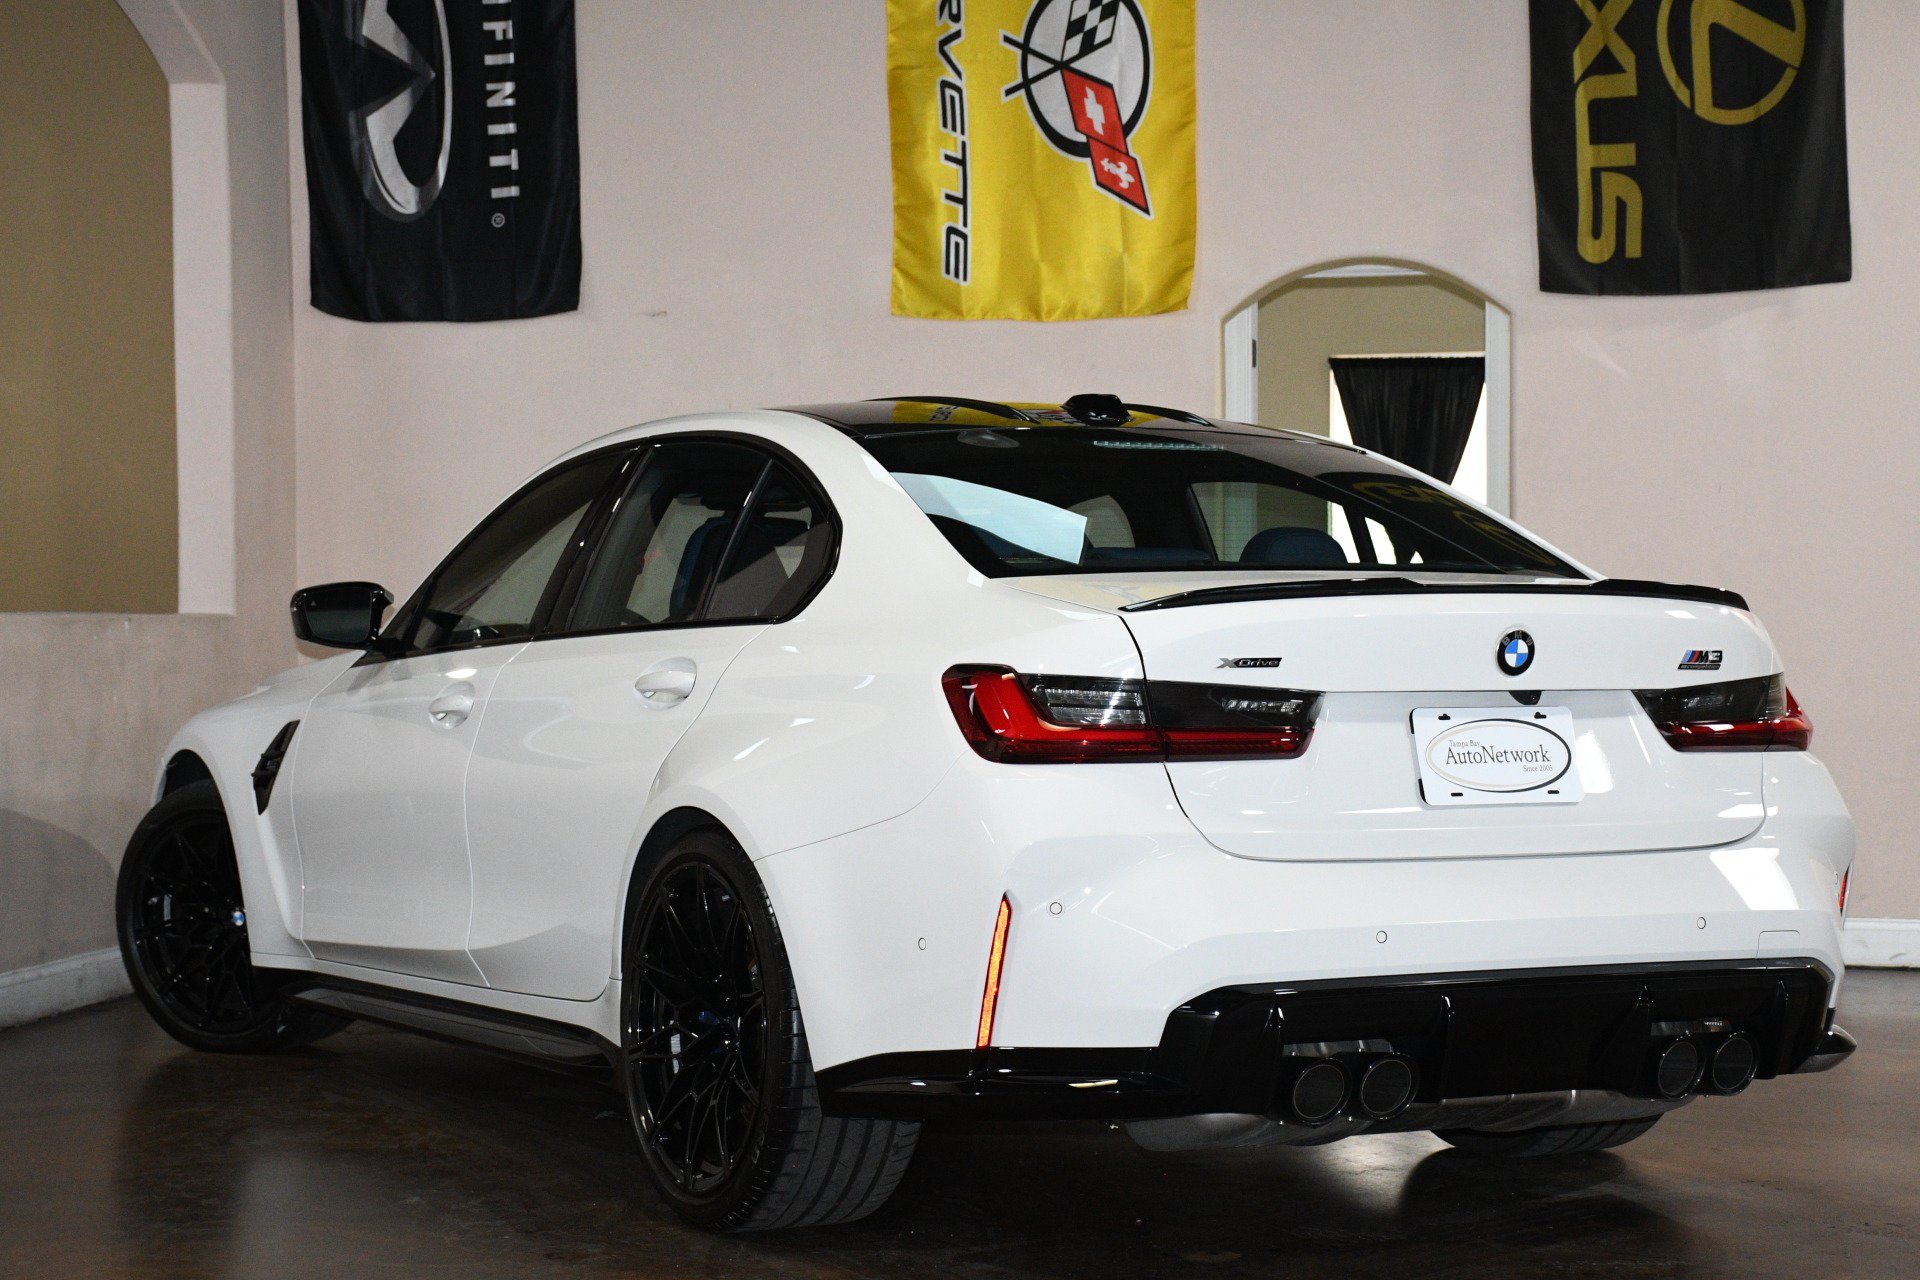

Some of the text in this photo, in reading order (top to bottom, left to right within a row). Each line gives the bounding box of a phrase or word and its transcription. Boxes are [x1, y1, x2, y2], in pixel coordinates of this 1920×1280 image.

[482, 0, 520, 198] FINITI
[1501, 630, 1534, 646] BMW
[1448, 739, 1480, 748] Tampa Bay
[1445, 744, 1551, 765] AutoNetwork
[1523, 764, 1538, 772] Since
